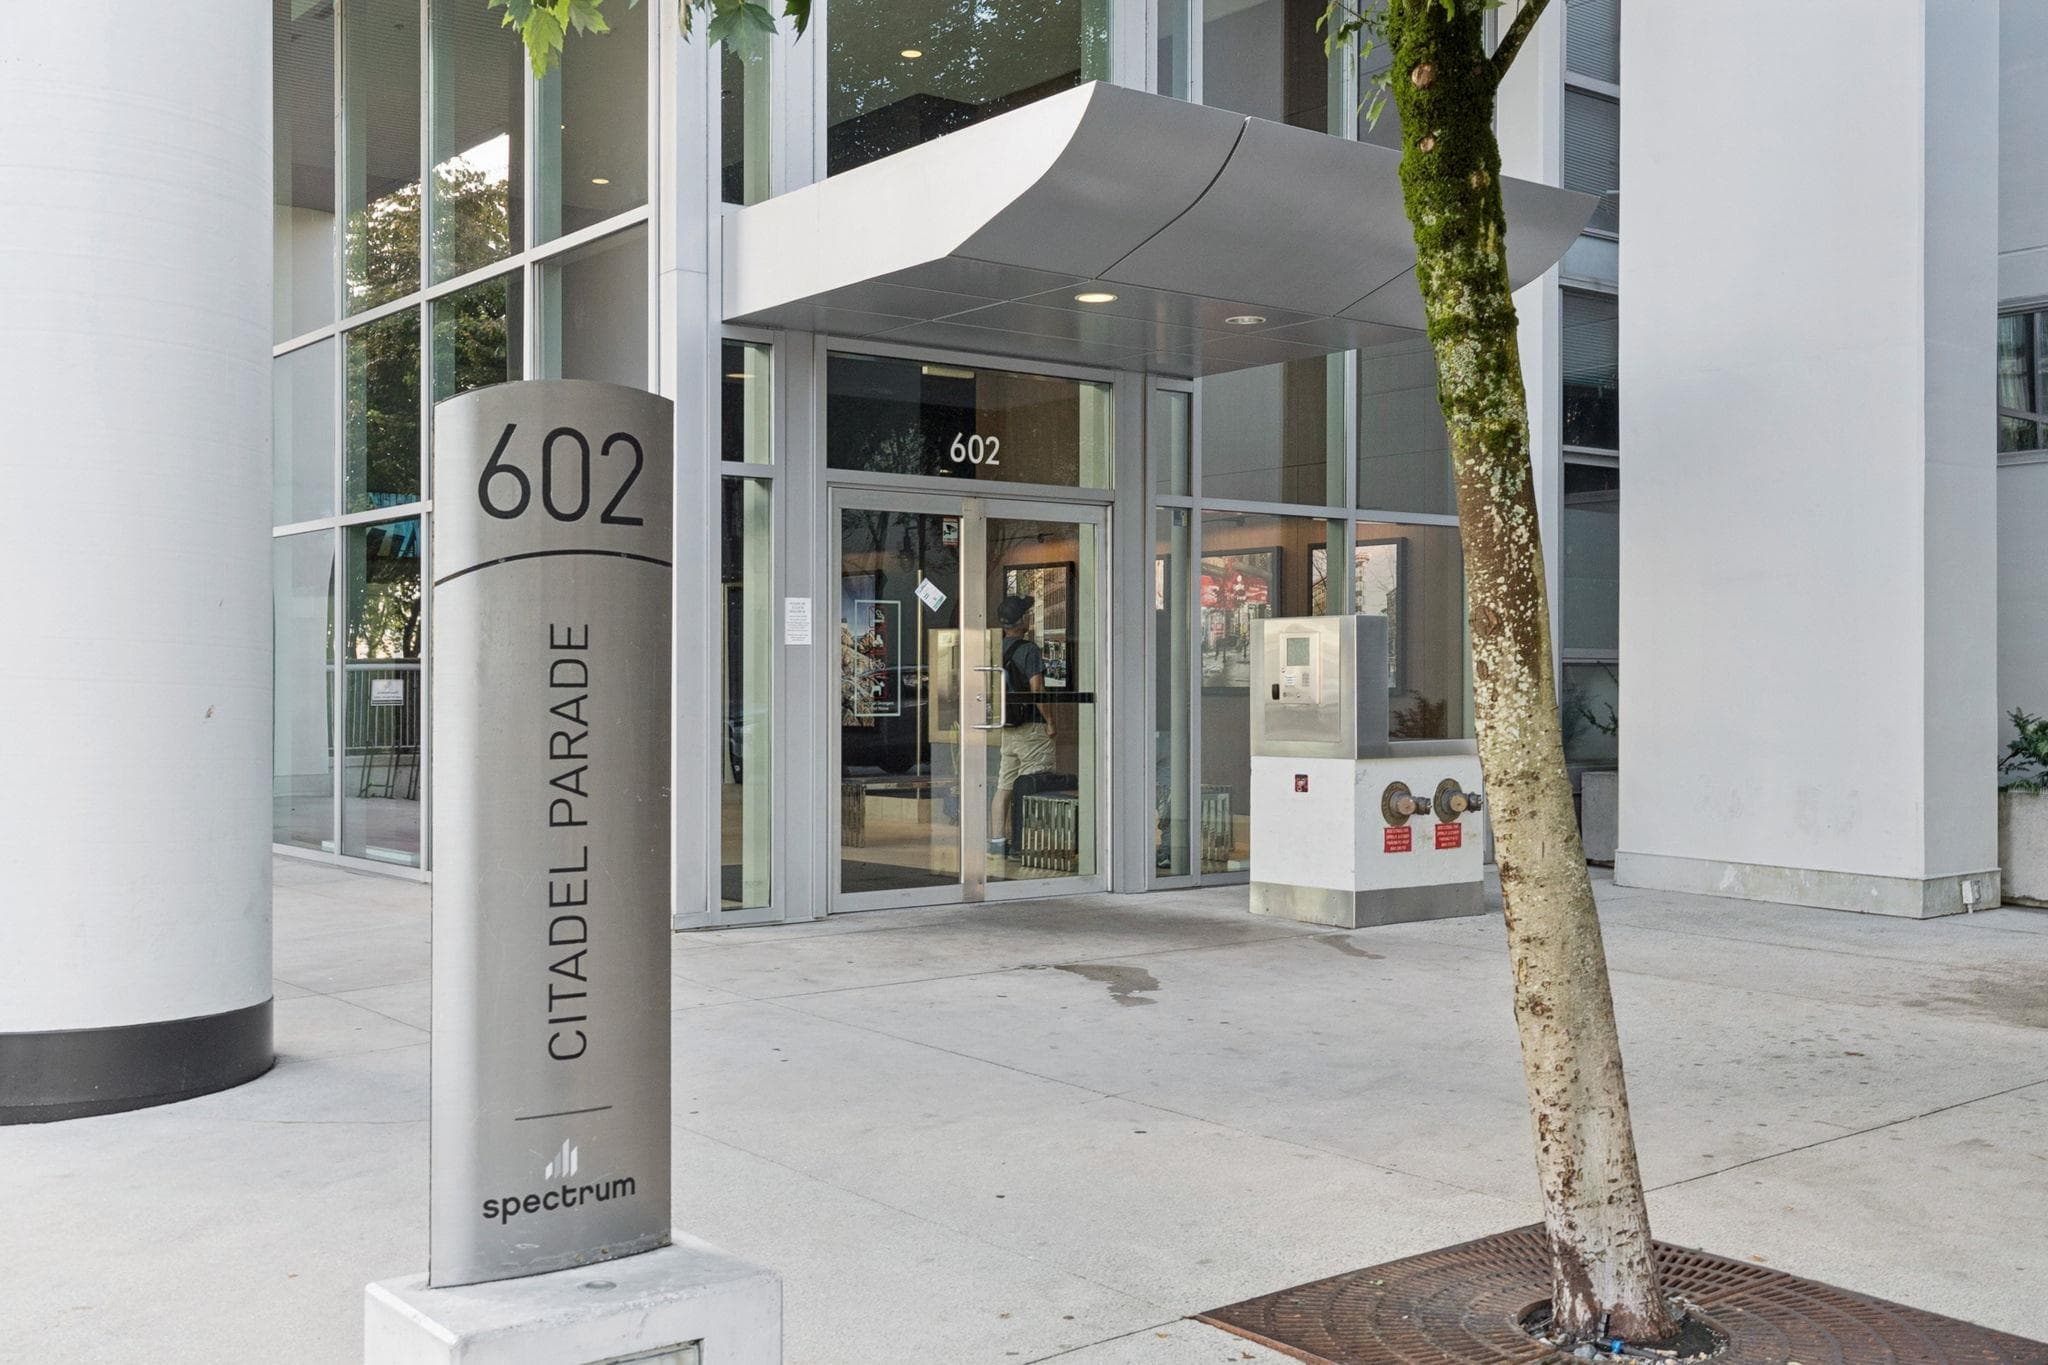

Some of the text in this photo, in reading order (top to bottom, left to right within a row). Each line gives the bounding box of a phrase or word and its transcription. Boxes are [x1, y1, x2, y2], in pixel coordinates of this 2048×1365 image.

[478, 423, 643, 526] 602
[949, 431, 1000, 466] 602
[548, 623, 588, 1061] CITADEL PARADE
[482, 1176, 636, 1225] spectrum
